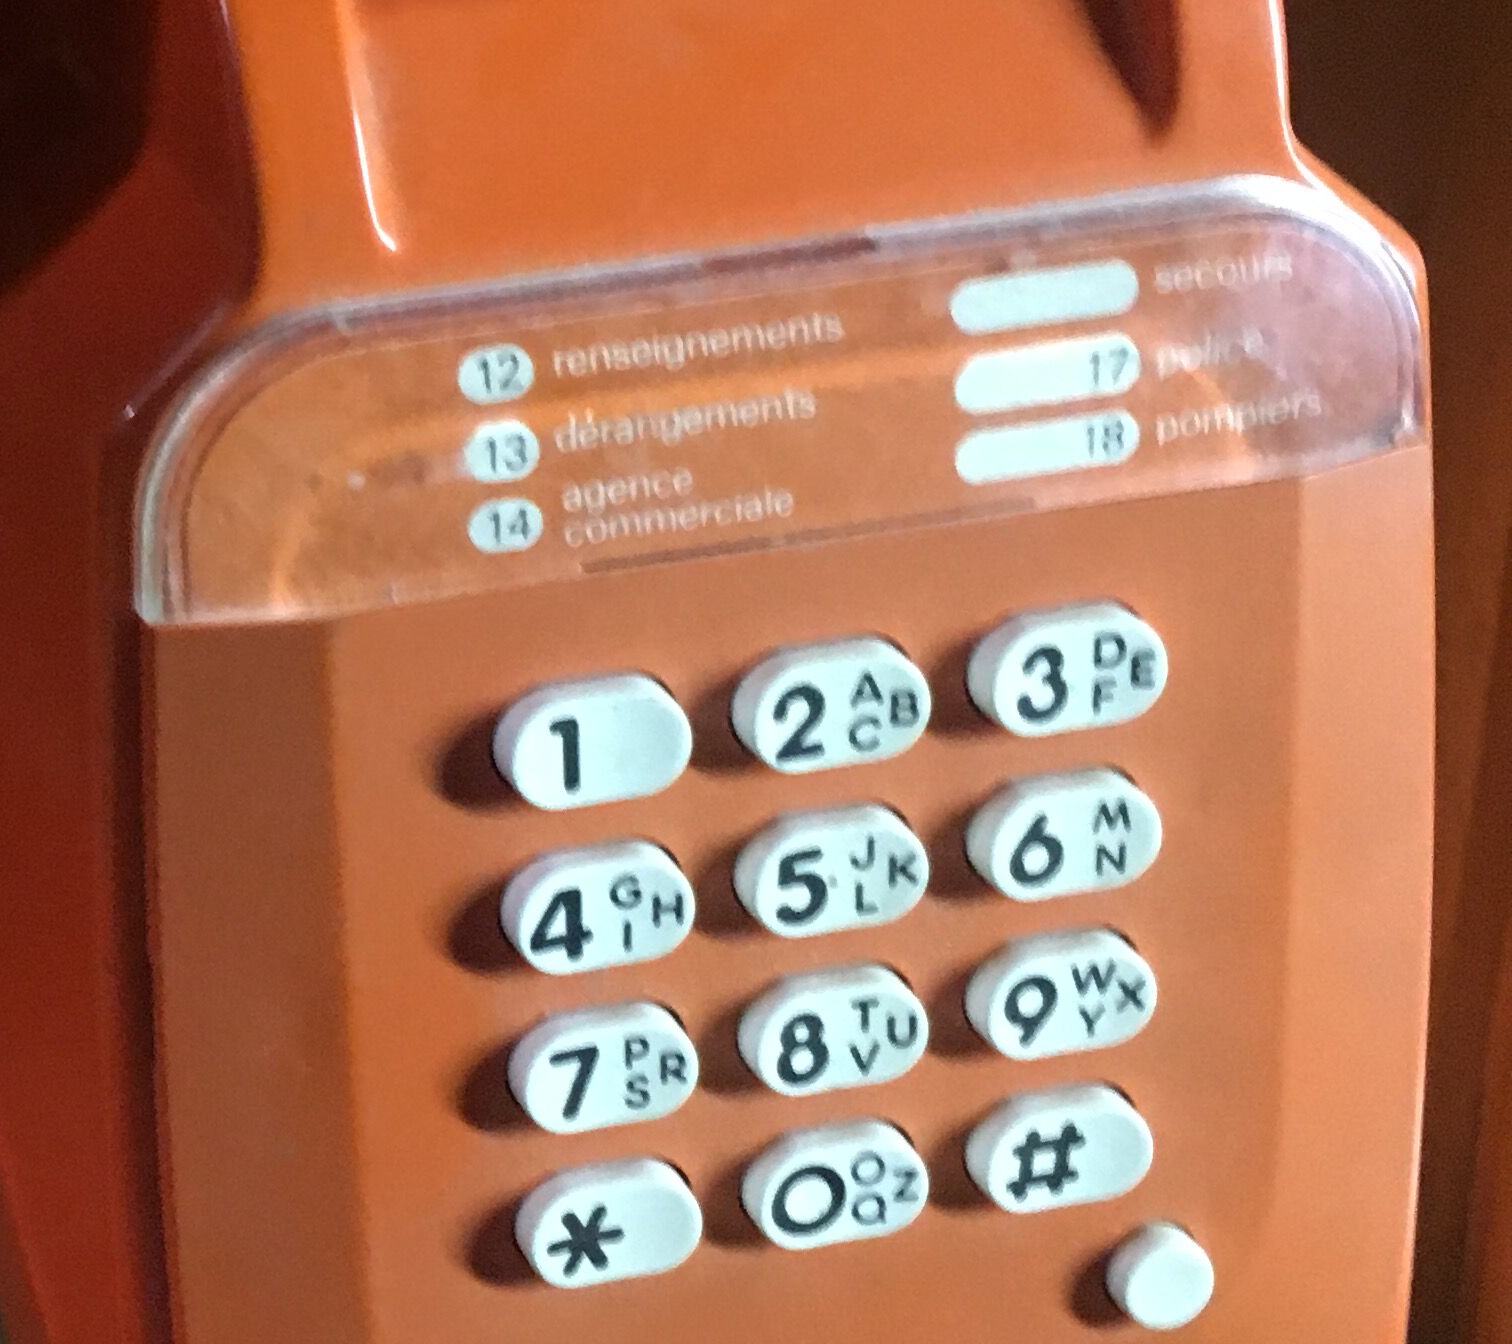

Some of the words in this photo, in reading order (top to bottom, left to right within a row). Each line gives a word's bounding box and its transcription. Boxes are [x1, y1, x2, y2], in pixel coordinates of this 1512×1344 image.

[477, 352, 525, 396] 12
[552, 311, 845, 379] renseignements
[1089, 346, 1130, 388] 17
[486, 431, 530, 475] 13
[554, 387, 817, 453] dérangements
[1087, 418, 1126, 459] 18
[487, 508, 532, 546] 14
[561, 464, 694, 515] agence
[563, 484, 795, 549] commerciale
[1016, 646, 1069, 723] 3
[549, 717, 581, 793] 1
[772, 683, 826, 763] 2
[775, 848, 829, 926] 5
[1009, 814, 1064, 887] 6
[529, 887, 594, 961] 4
[1003, 974, 1058, 1046] 9
[549, 1045, 600, 1120] 7
[776, 1012, 830, 1087] 8
